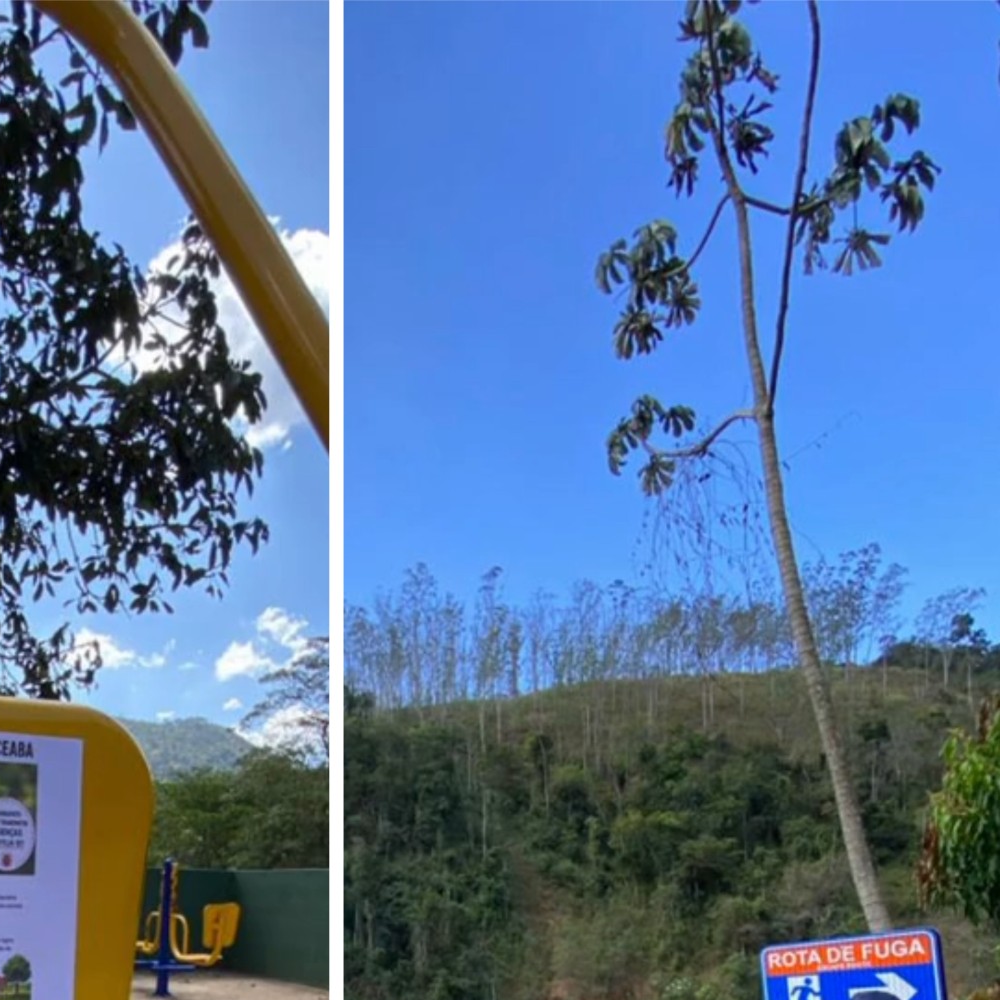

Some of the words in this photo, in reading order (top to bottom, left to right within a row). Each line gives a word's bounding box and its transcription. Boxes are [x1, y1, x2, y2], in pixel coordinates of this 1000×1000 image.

[768, 951, 821, 968] ROTA
[827, 946, 855, 963] DE
[862, 939, 925, 960] FUGA
